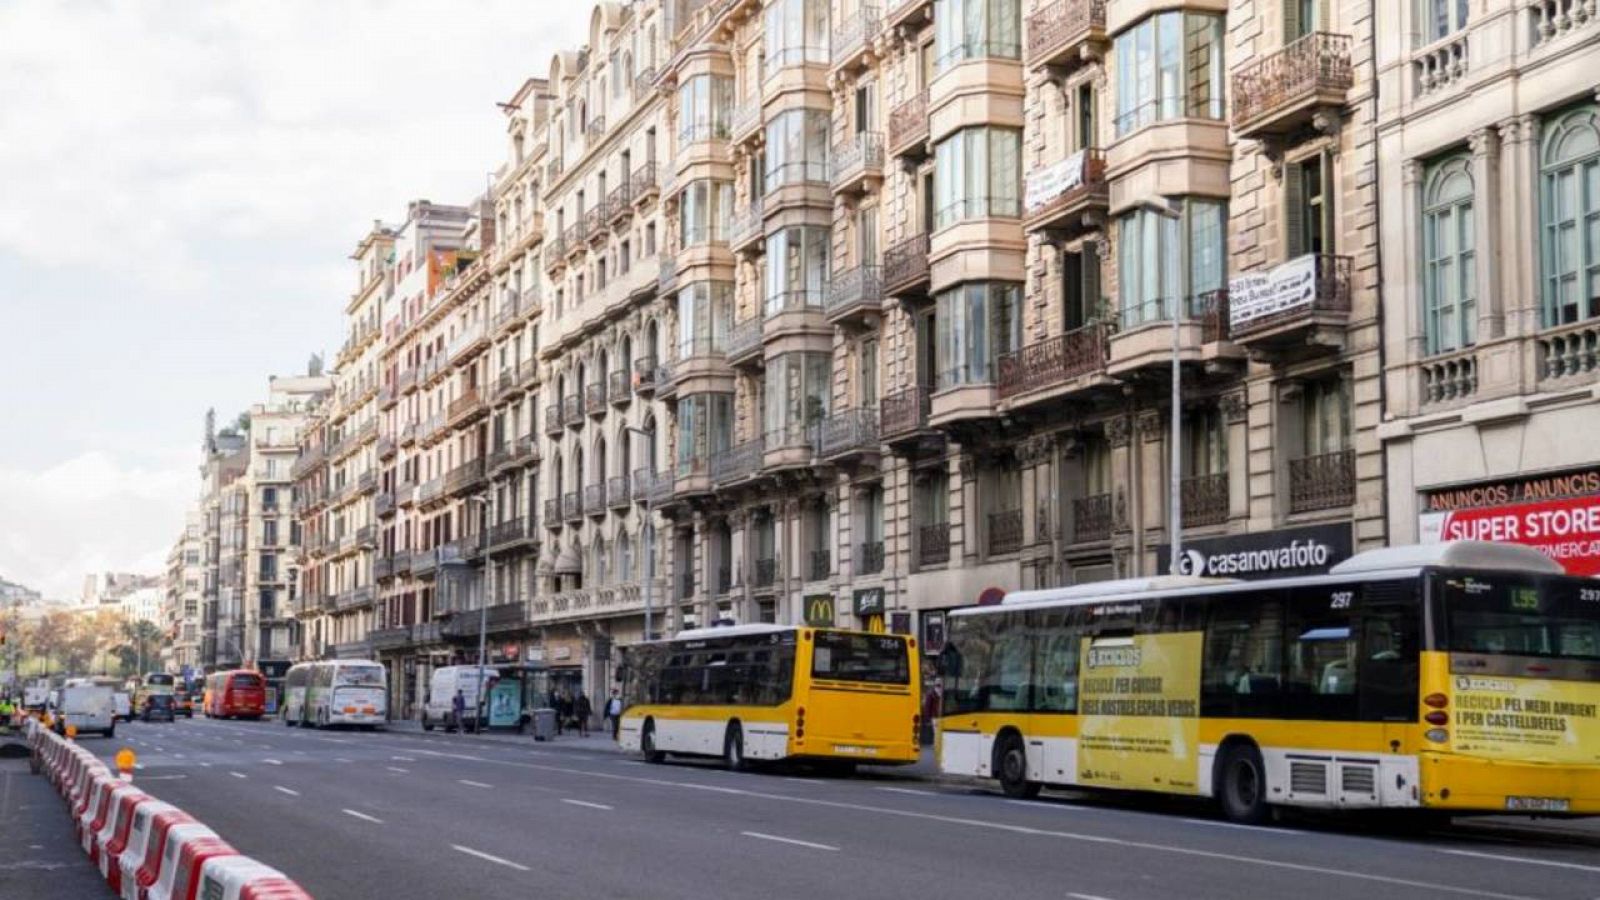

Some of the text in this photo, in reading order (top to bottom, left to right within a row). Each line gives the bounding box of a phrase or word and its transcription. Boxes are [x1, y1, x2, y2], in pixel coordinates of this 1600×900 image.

[1430, 485, 1508, 510] ANUNCIOS
[1523, 472, 1600, 501] ANUNCIS
[1450, 505, 1600, 541] SUPER STORE
[1208, 540, 1327, 575] casanovafoto
[1330, 592, 1353, 609] 297
[1580, 588, 1600, 601] 297
[1115, 678, 1130, 694] PER
[1455, 694, 1597, 718] RECICLA PEL MEDI AMBIENT
[1456, 711, 1567, 732] I PER CASTELLDEFELS
